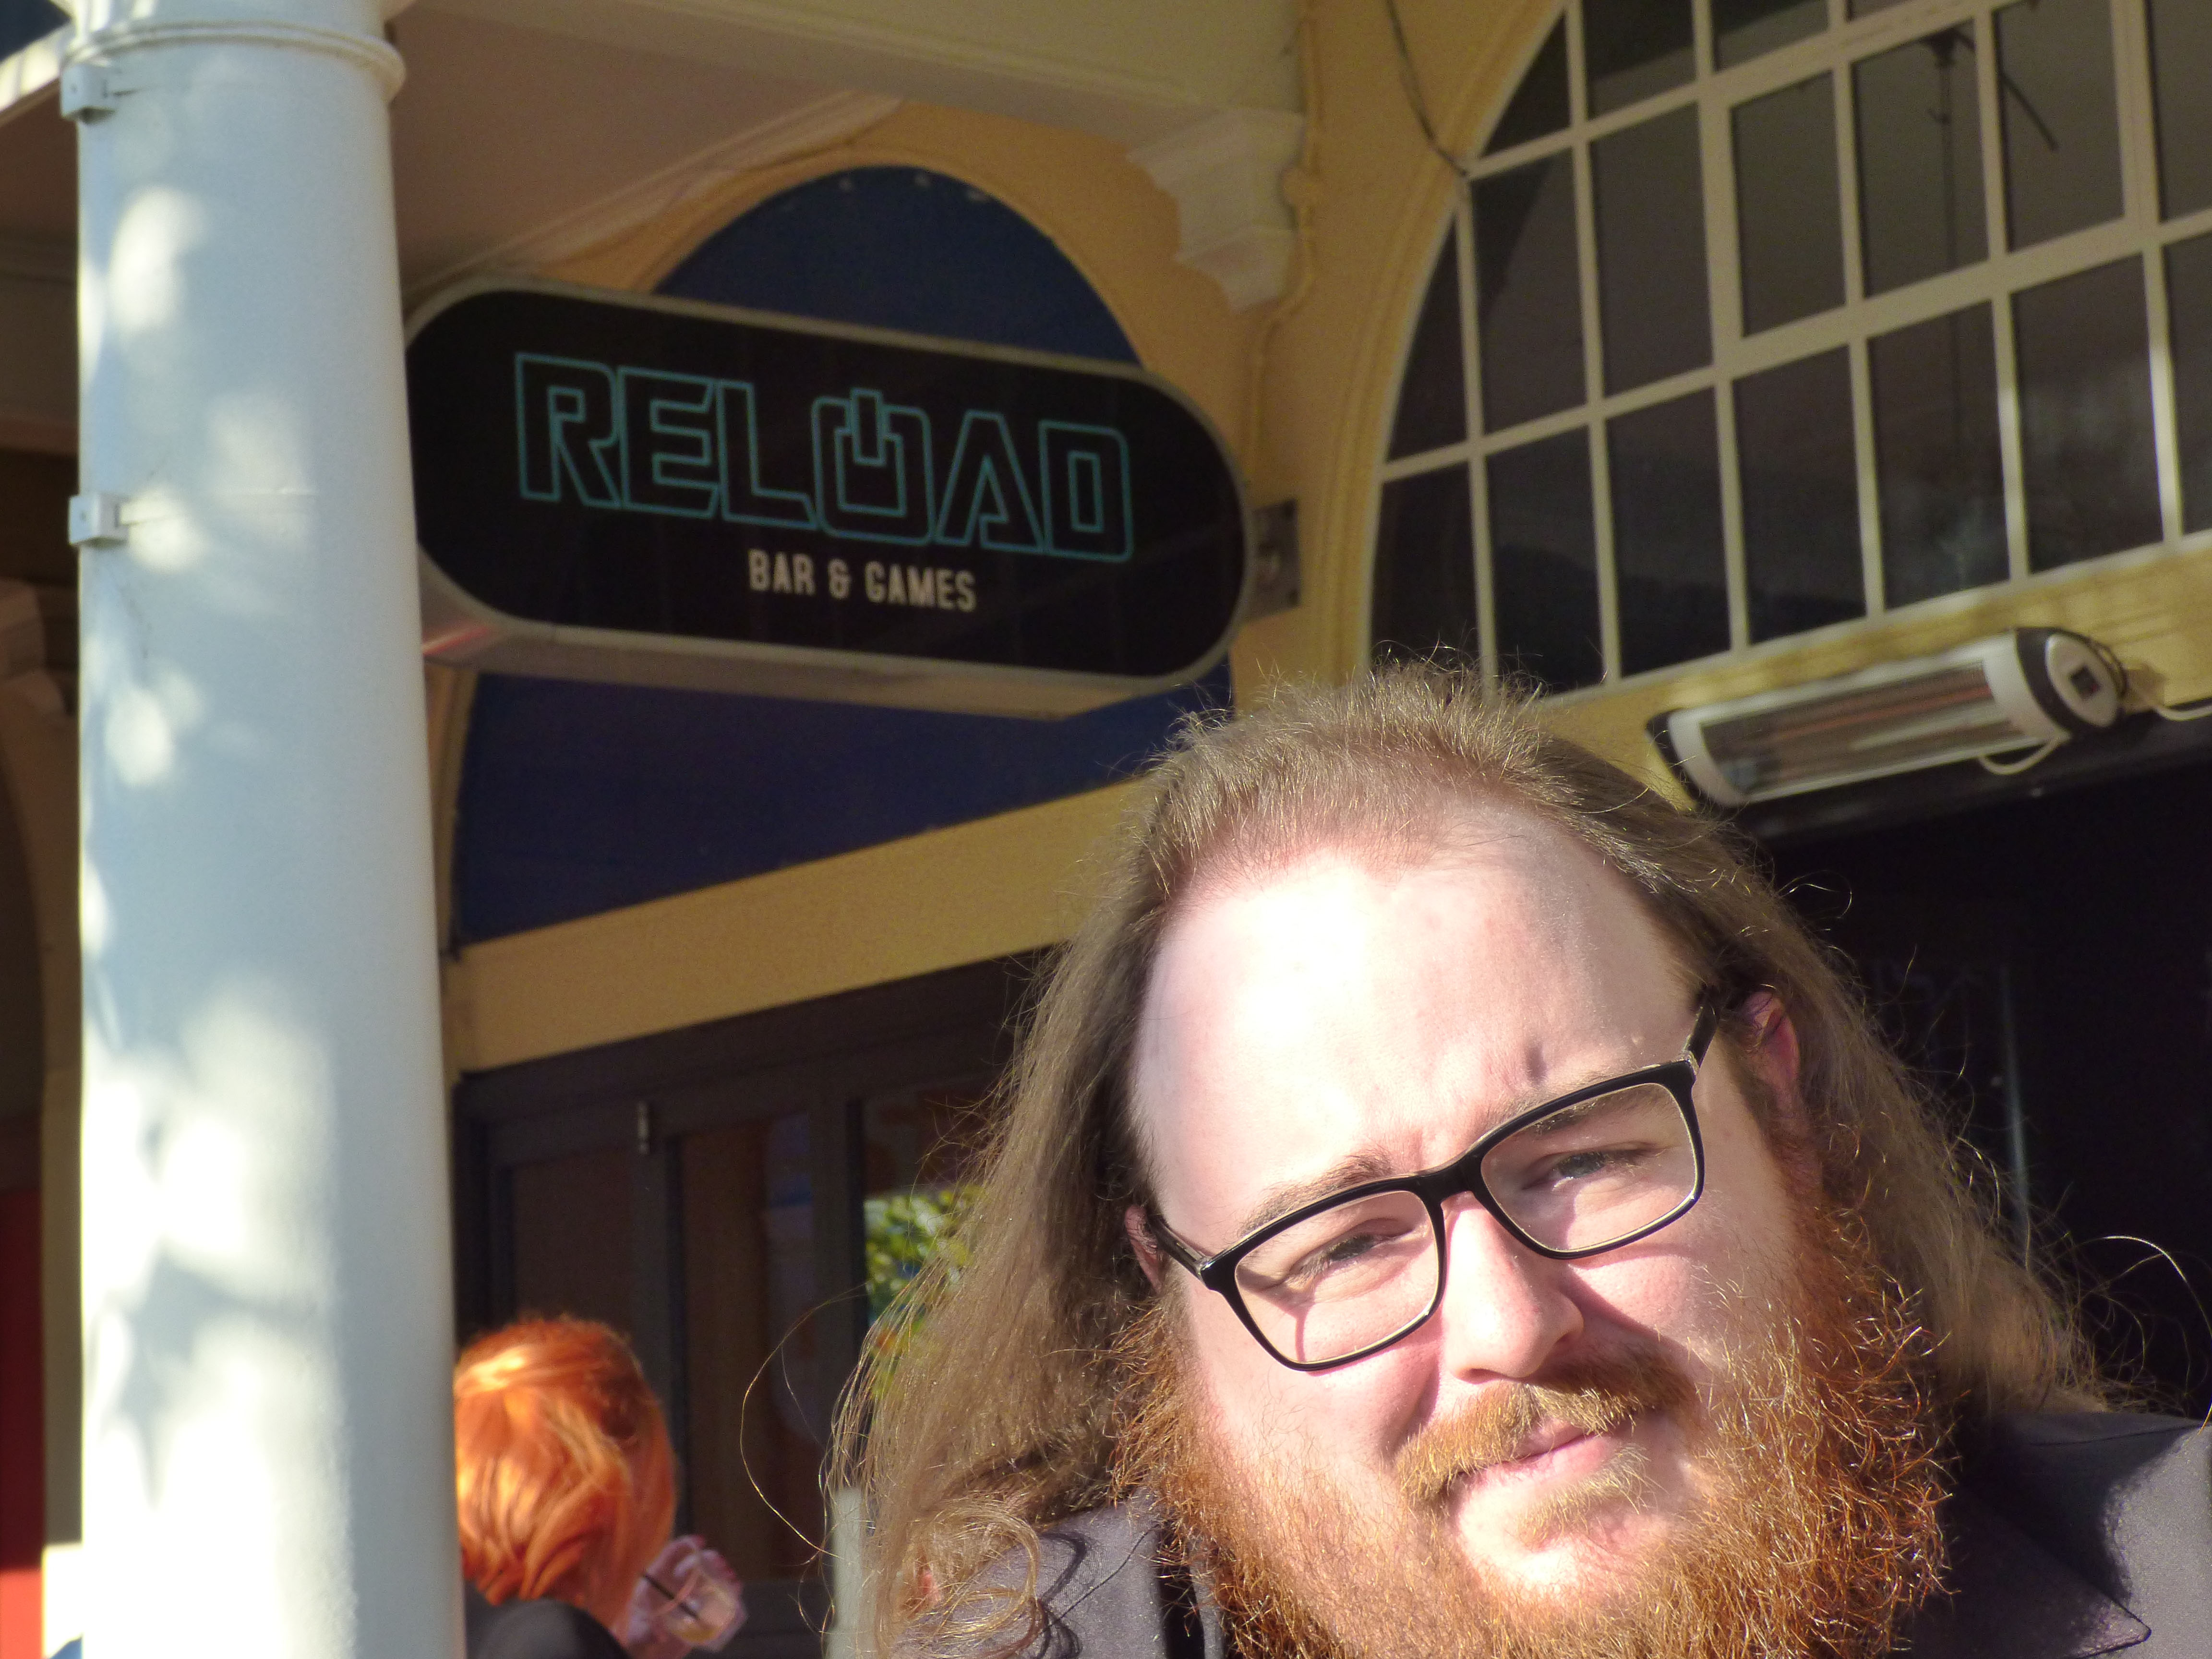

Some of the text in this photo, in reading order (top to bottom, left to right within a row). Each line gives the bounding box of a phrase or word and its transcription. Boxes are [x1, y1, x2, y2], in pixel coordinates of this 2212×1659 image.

[516, 352, 1134, 562] RELOAD
[747, 548, 976, 612] BAR & GAMES
